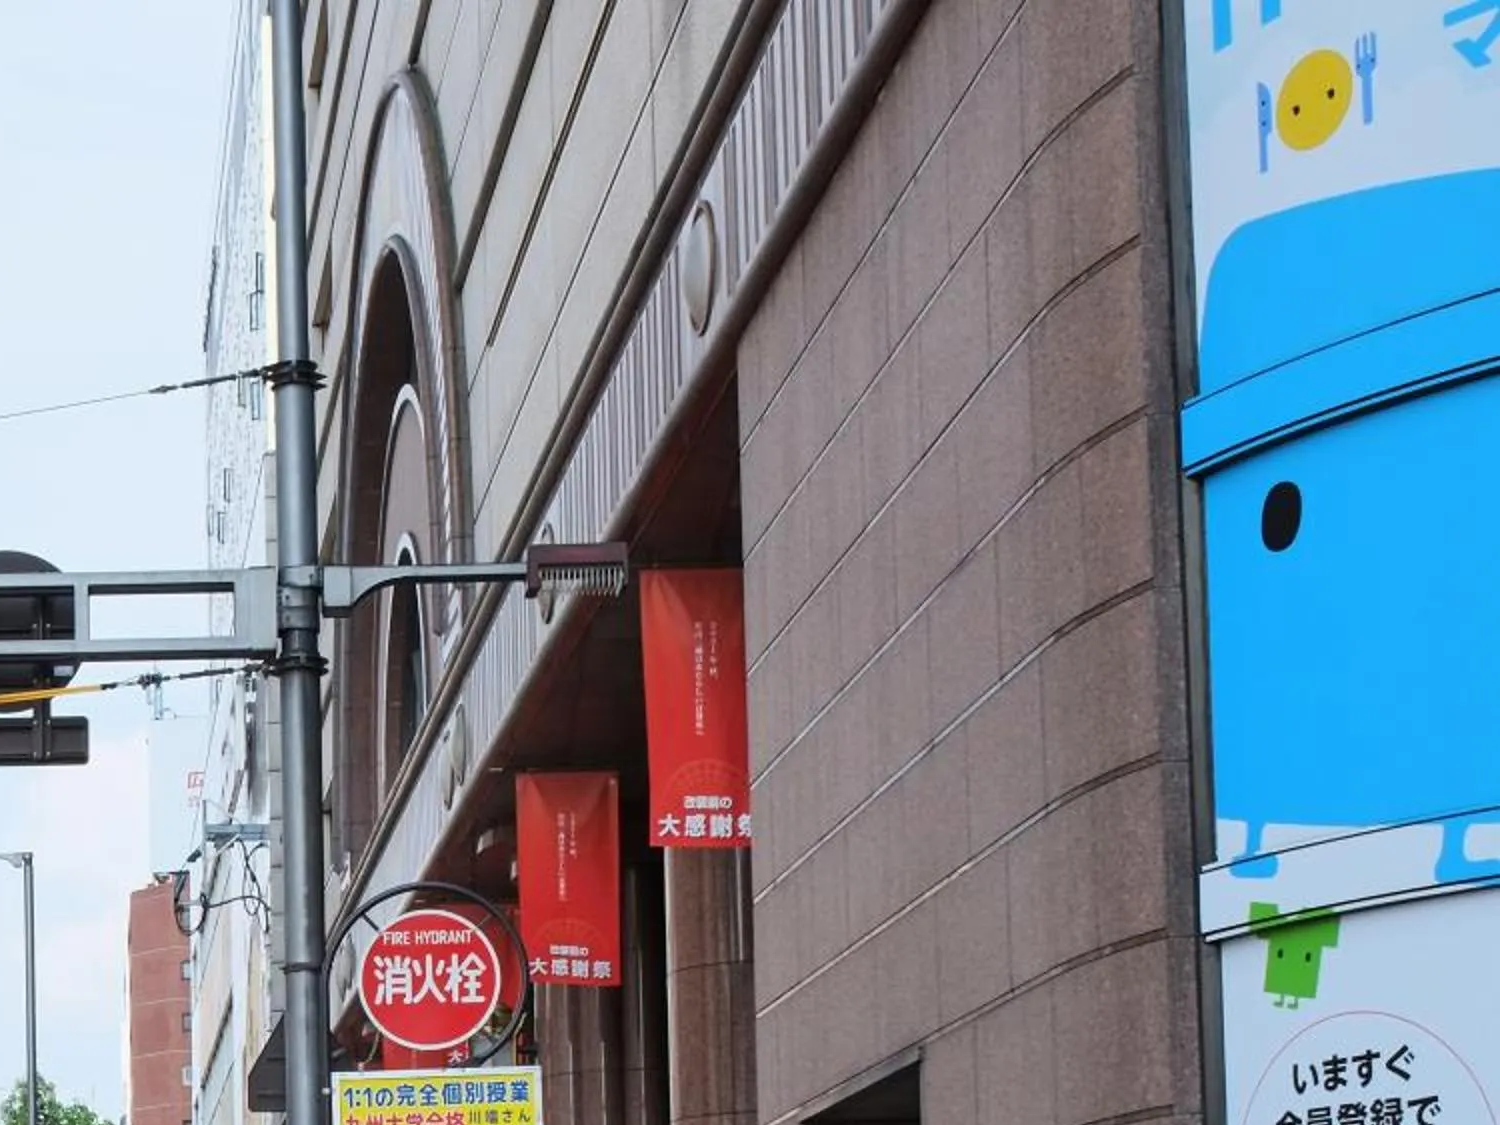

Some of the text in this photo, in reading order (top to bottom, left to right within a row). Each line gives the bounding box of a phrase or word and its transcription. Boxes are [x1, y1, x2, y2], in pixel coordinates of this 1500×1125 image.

[383, 930, 472, 945] FIRE HYDRANT
[373, 952, 487, 1006] 消火栓
[529, 957, 612, 979] 大感謝祭
[1292, 1044, 1415, 1095] いますぐ
[344, 1080, 529, 1109] 1:1の完全個別授業
